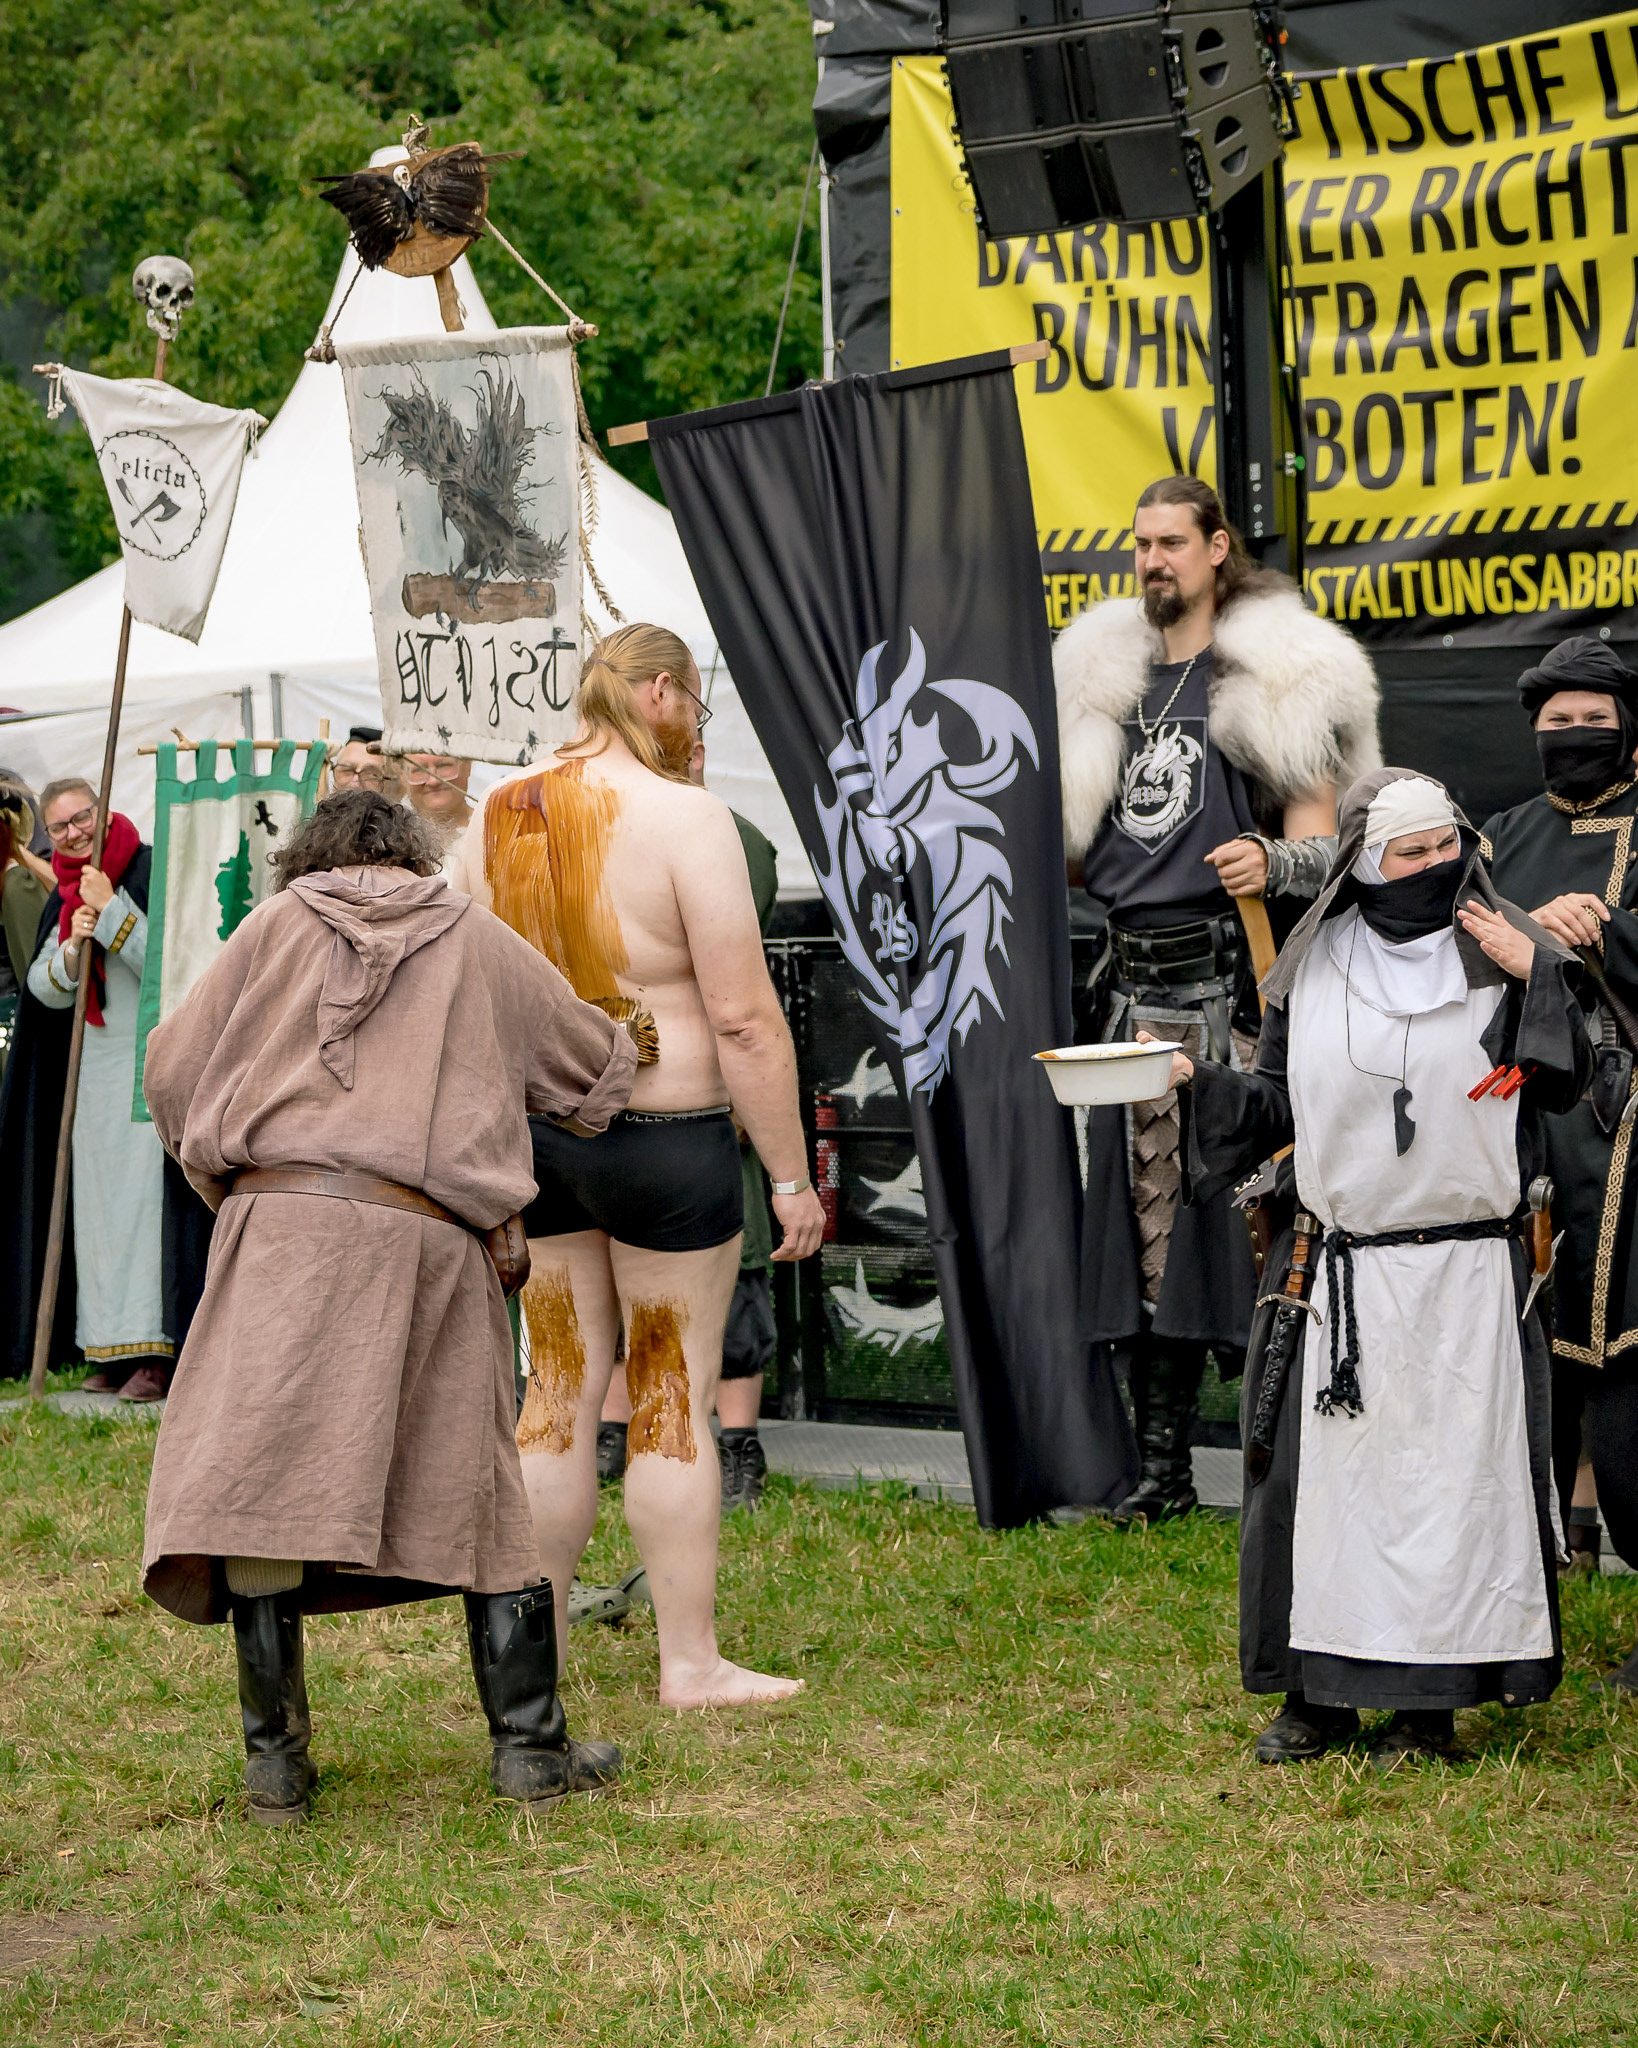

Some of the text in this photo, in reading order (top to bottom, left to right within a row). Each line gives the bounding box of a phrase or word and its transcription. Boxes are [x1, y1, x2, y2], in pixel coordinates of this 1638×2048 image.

[1293, 26, 1638, 159] TISCHE U
[1410, 133, 1638, 255] RICHT
[1033, 284, 1214, 395] BÜHN
[1286, 258, 1601, 378] TRAGEN
[110, 451, 186, 489] elicta
[1303, 548, 1638, 620] STALTUNGSABBR
